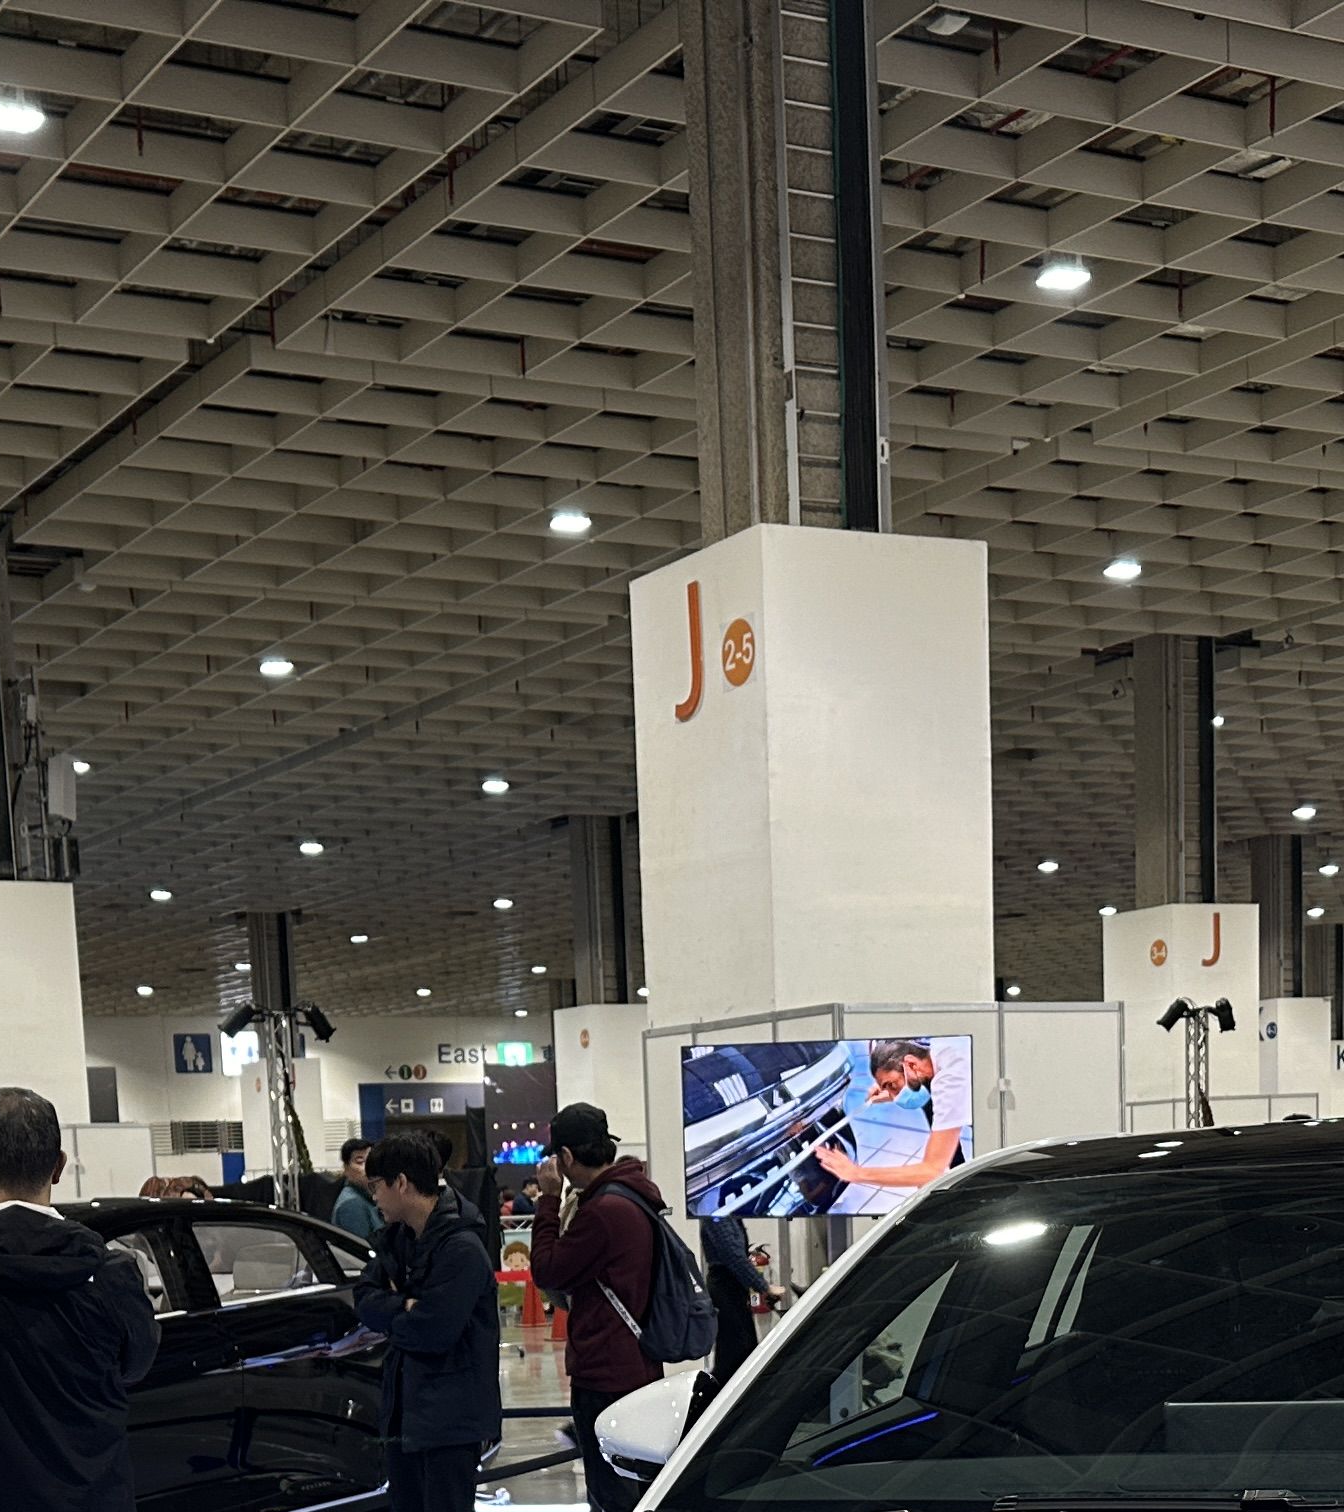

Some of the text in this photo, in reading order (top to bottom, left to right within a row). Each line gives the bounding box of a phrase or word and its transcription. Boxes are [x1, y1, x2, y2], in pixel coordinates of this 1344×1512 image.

[674, 579, 704, 723] J
[723, 631, 754, 671] 2-5
[1201, 912, 1221, 967] J
[437, 1043, 486, 1065] East
